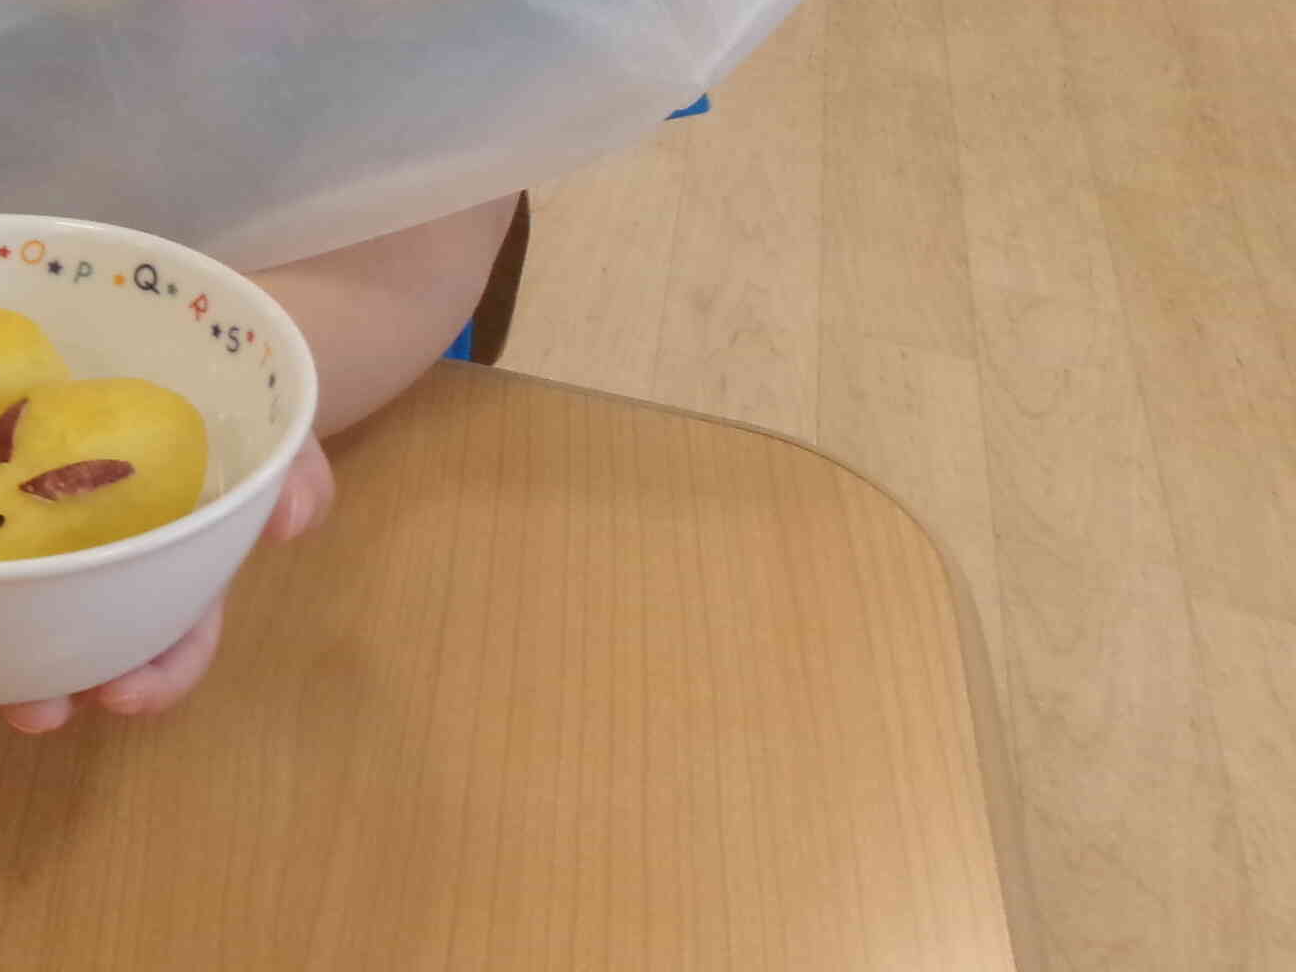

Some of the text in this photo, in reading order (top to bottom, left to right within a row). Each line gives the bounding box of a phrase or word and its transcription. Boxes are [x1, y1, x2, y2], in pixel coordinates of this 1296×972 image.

[20, 239, 46, 265] O
[74, 260, 94, 283] P
[133, 263, 160, 295] Q
[189, 294, 208, 321] R
[225, 326, 240, 353] S
